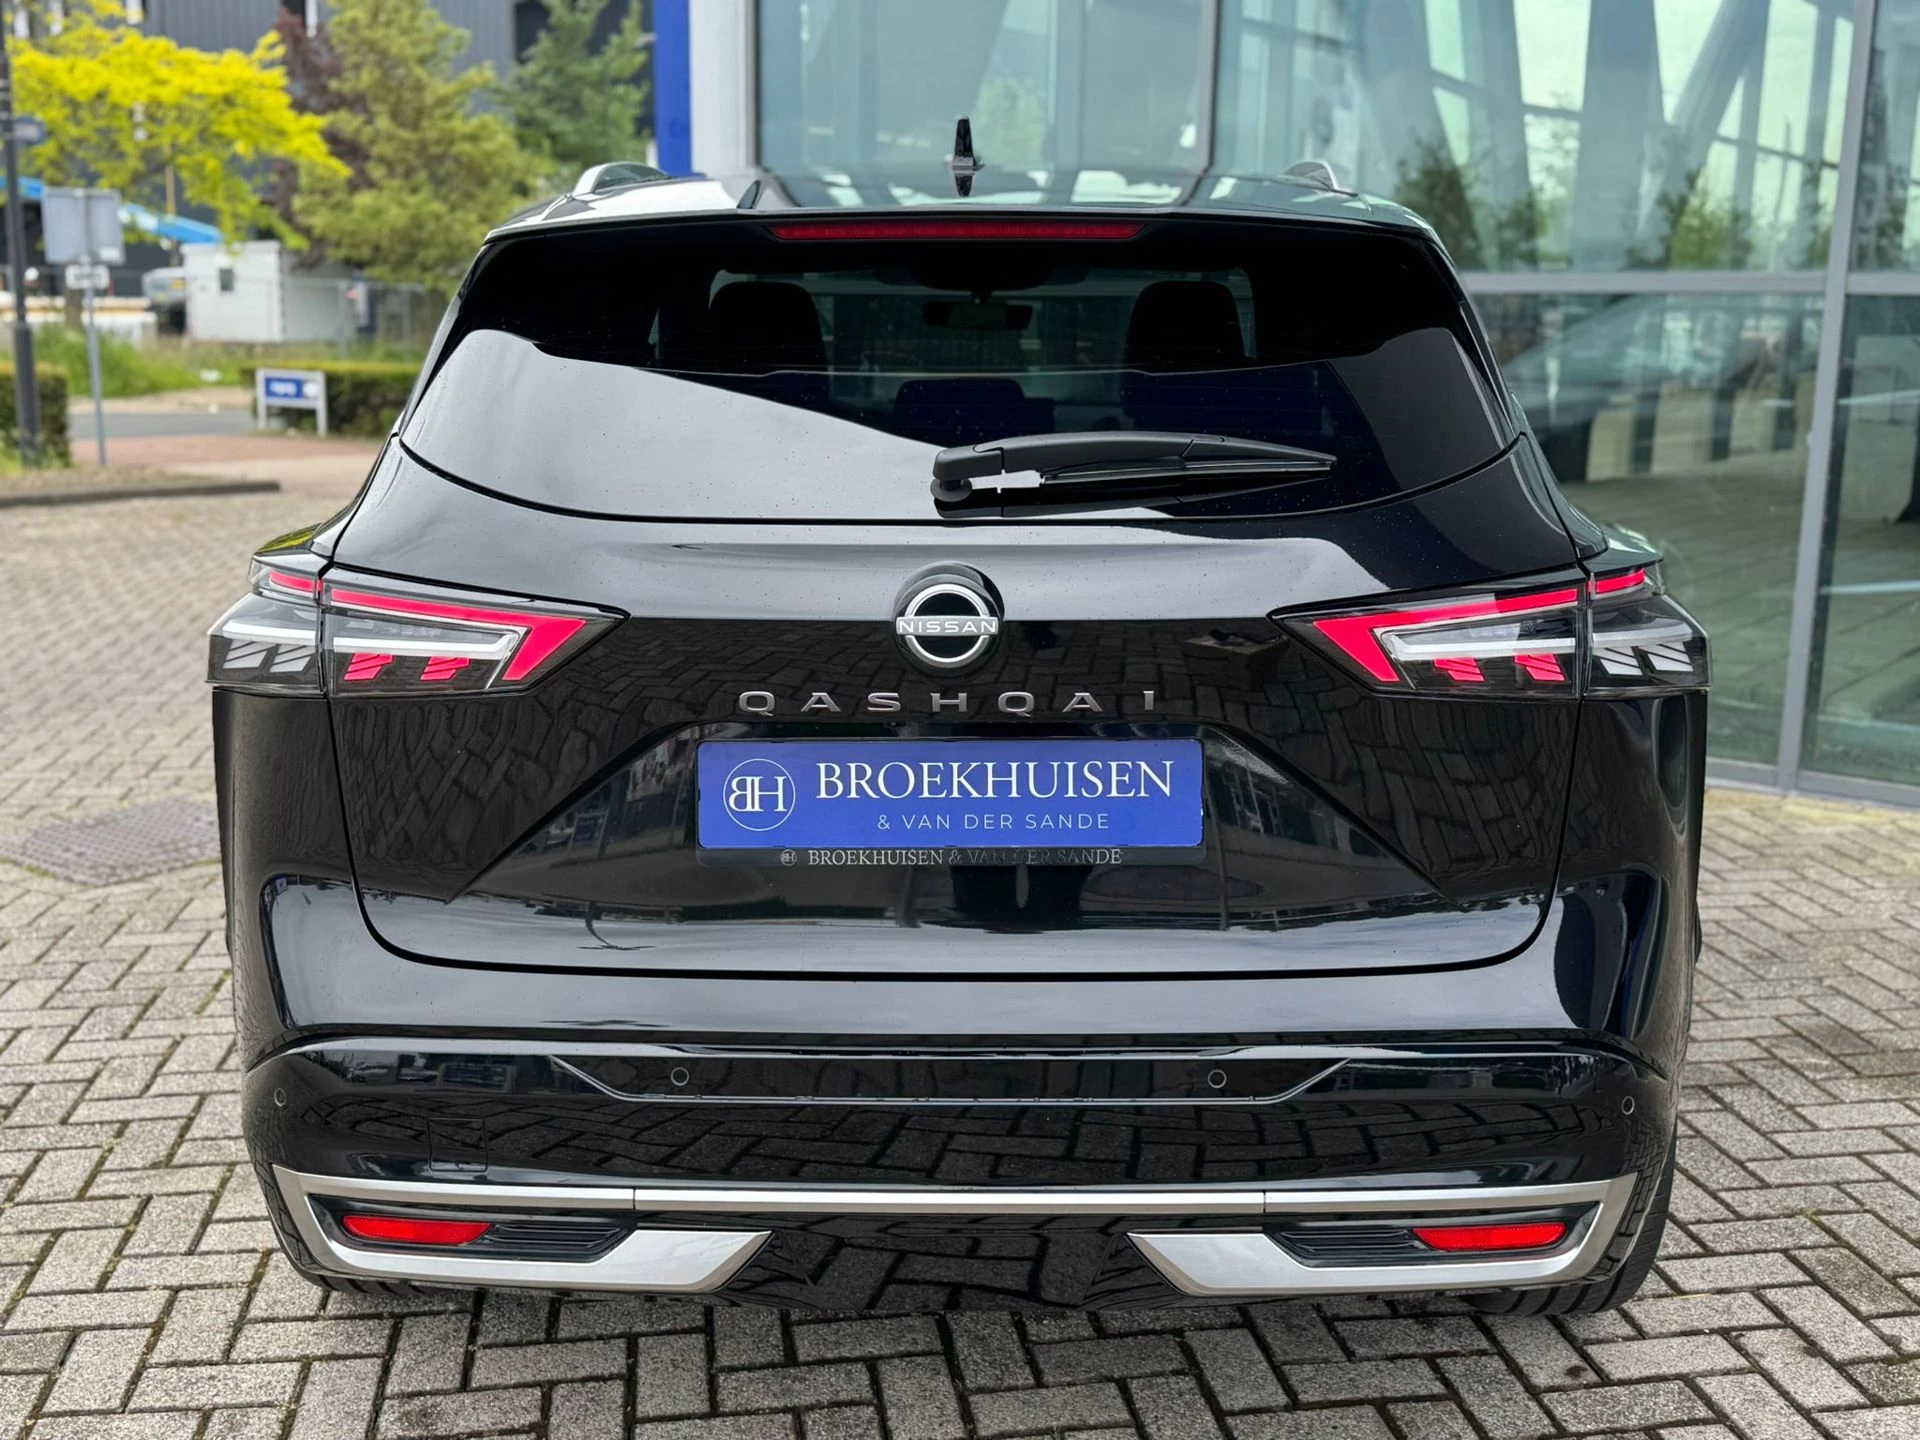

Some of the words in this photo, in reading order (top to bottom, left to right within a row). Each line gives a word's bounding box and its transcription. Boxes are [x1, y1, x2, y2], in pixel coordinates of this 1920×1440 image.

[899, 620, 996, 633] NISSAN
[738, 690, 1156, 716] QASHQAI
[815, 760, 1174, 799] BROEKHUISEN
[877, 814, 890, 830] &
[902, 813, 950, 830] VAN
[964, 813, 1013, 830] DER
[1025, 813, 1110, 830] SANDE
[808, 849, 943, 866] BROEKHUISEN
[948, 849, 963, 865] &
[1056, 849, 1123, 865] SANDE
